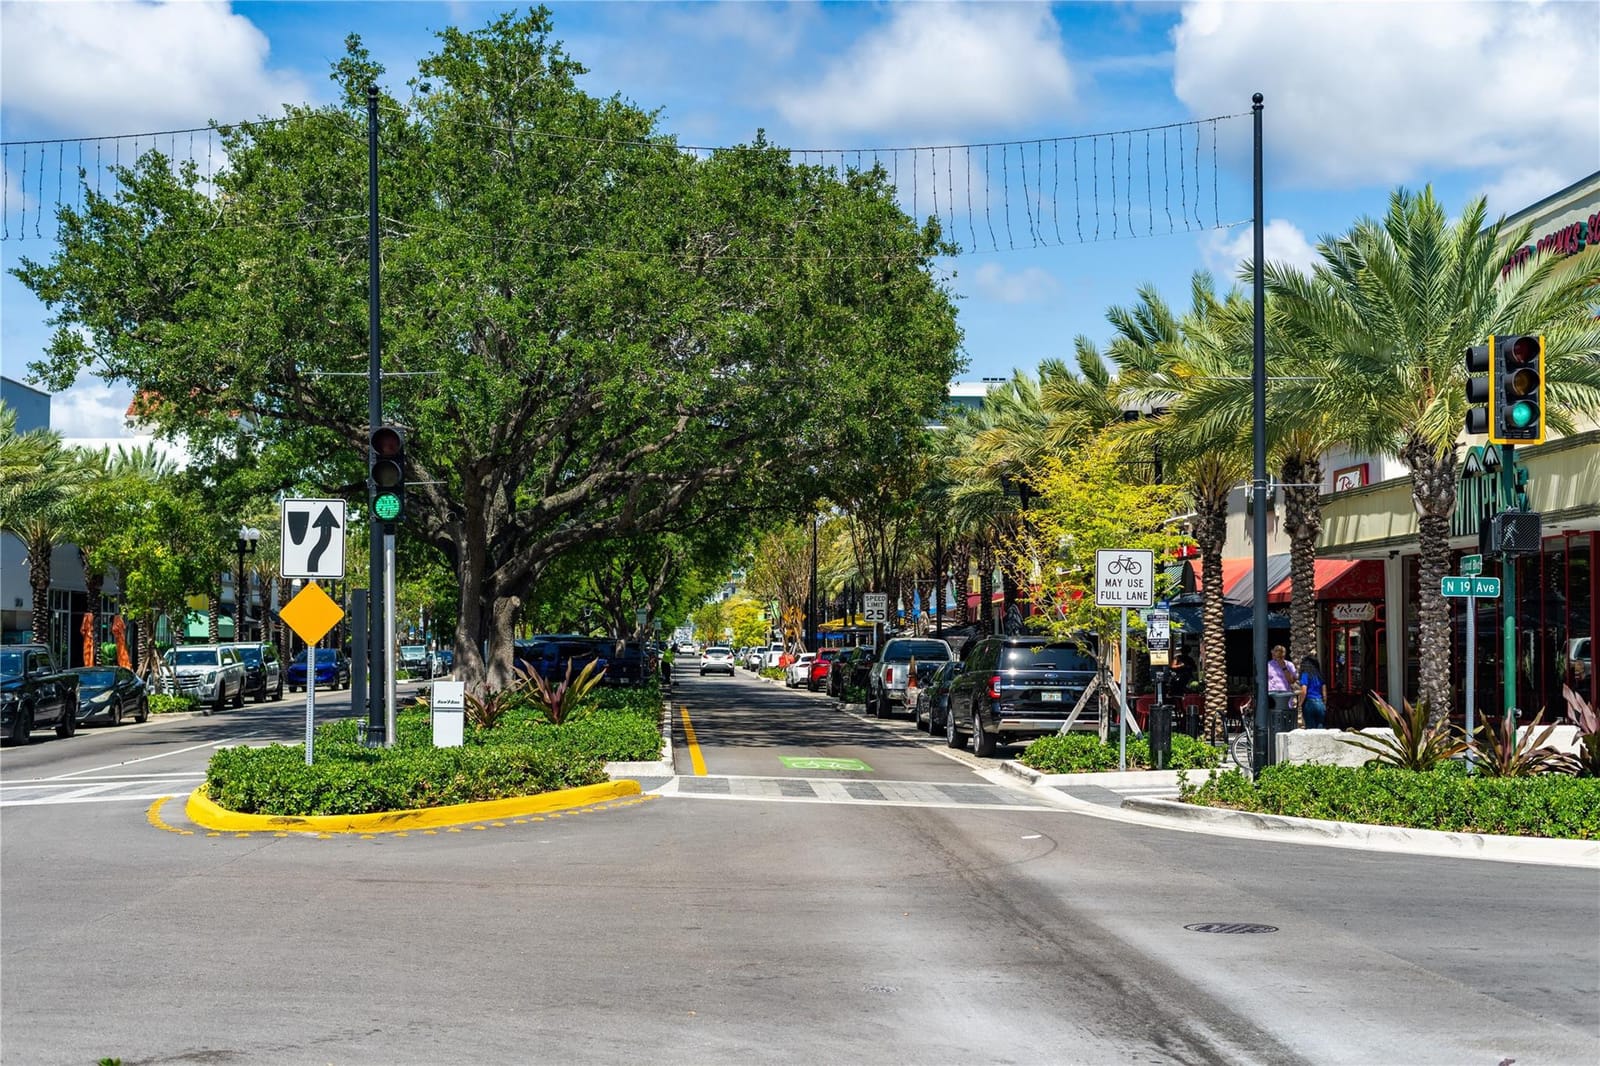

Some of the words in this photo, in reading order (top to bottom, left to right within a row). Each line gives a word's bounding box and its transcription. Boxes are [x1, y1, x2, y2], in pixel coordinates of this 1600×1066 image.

[1105, 578, 1122, 588] MAY
[1127, 579, 1144, 588] USE
[1447, 581, 1454, 593] N
[1460, 581, 1471, 593] 19
[1476, 582, 1495, 593] Ave
[1101, 591, 1121, 600] FULL
[1126, 591, 1148, 601] LANE
[866, 609, 885, 620] 25
